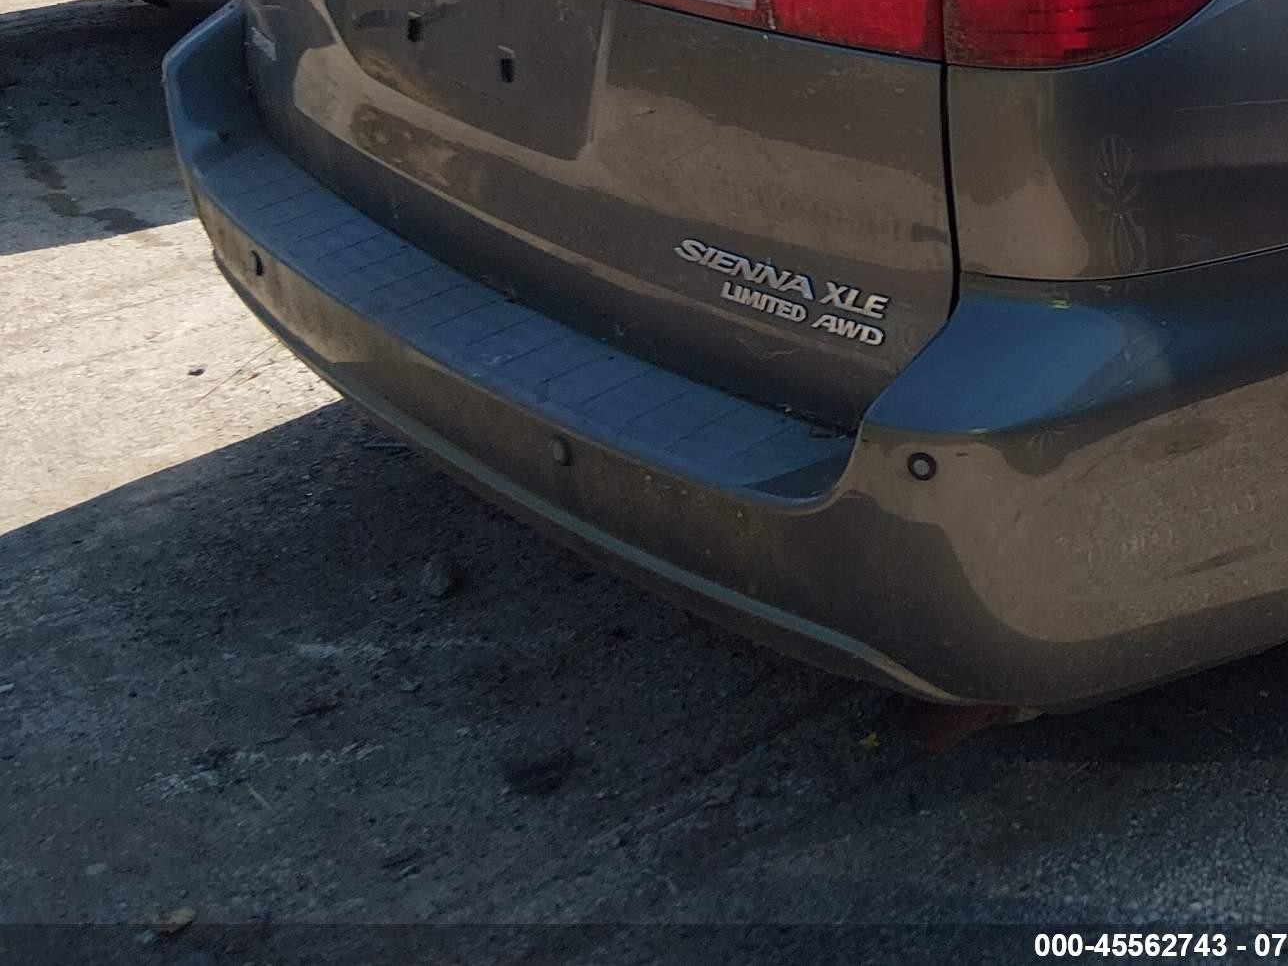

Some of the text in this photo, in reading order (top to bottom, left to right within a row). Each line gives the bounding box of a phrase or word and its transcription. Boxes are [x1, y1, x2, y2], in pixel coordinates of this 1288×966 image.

[674, 238, 890, 320] SIENNA XLE
[720, 281, 885, 347] LIMITED AWD
